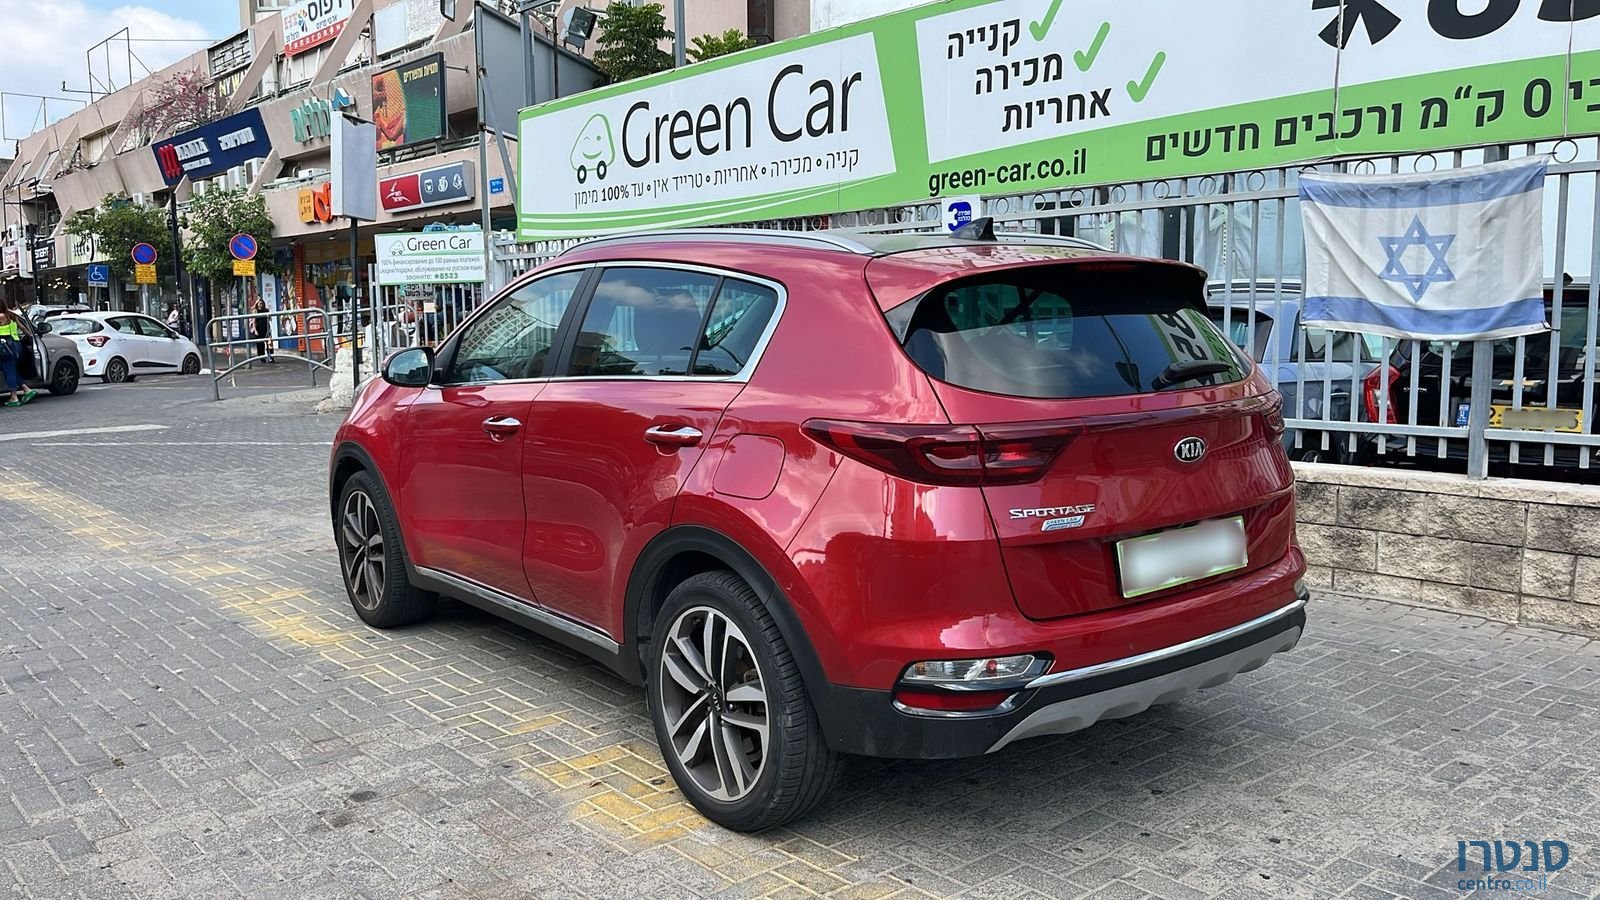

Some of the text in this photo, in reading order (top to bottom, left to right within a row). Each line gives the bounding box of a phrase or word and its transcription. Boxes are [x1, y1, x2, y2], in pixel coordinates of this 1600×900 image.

[948, 19, 1020, 59] קנייה
[976, 53, 1063, 95] מכירה
[623, 65, 862, 169] Green Car
[1002, 88, 1112, 133] אחריות
[1524, 78, 1552, 118] 0
[1147, 123, 1260, 162] חדשים
[1275, 103, 1402, 147] ורכבים
[574, 149, 859, 210] קניה מכירה אחריות טרייד אין עד 100% מימון
[929, 149, 1087, 197] green-car.co.il
[407, 235, 472, 252] Green Car
[1181, 442, 1202, 458] KIA
[1009, 503, 1096, 519] SPORTAGE
